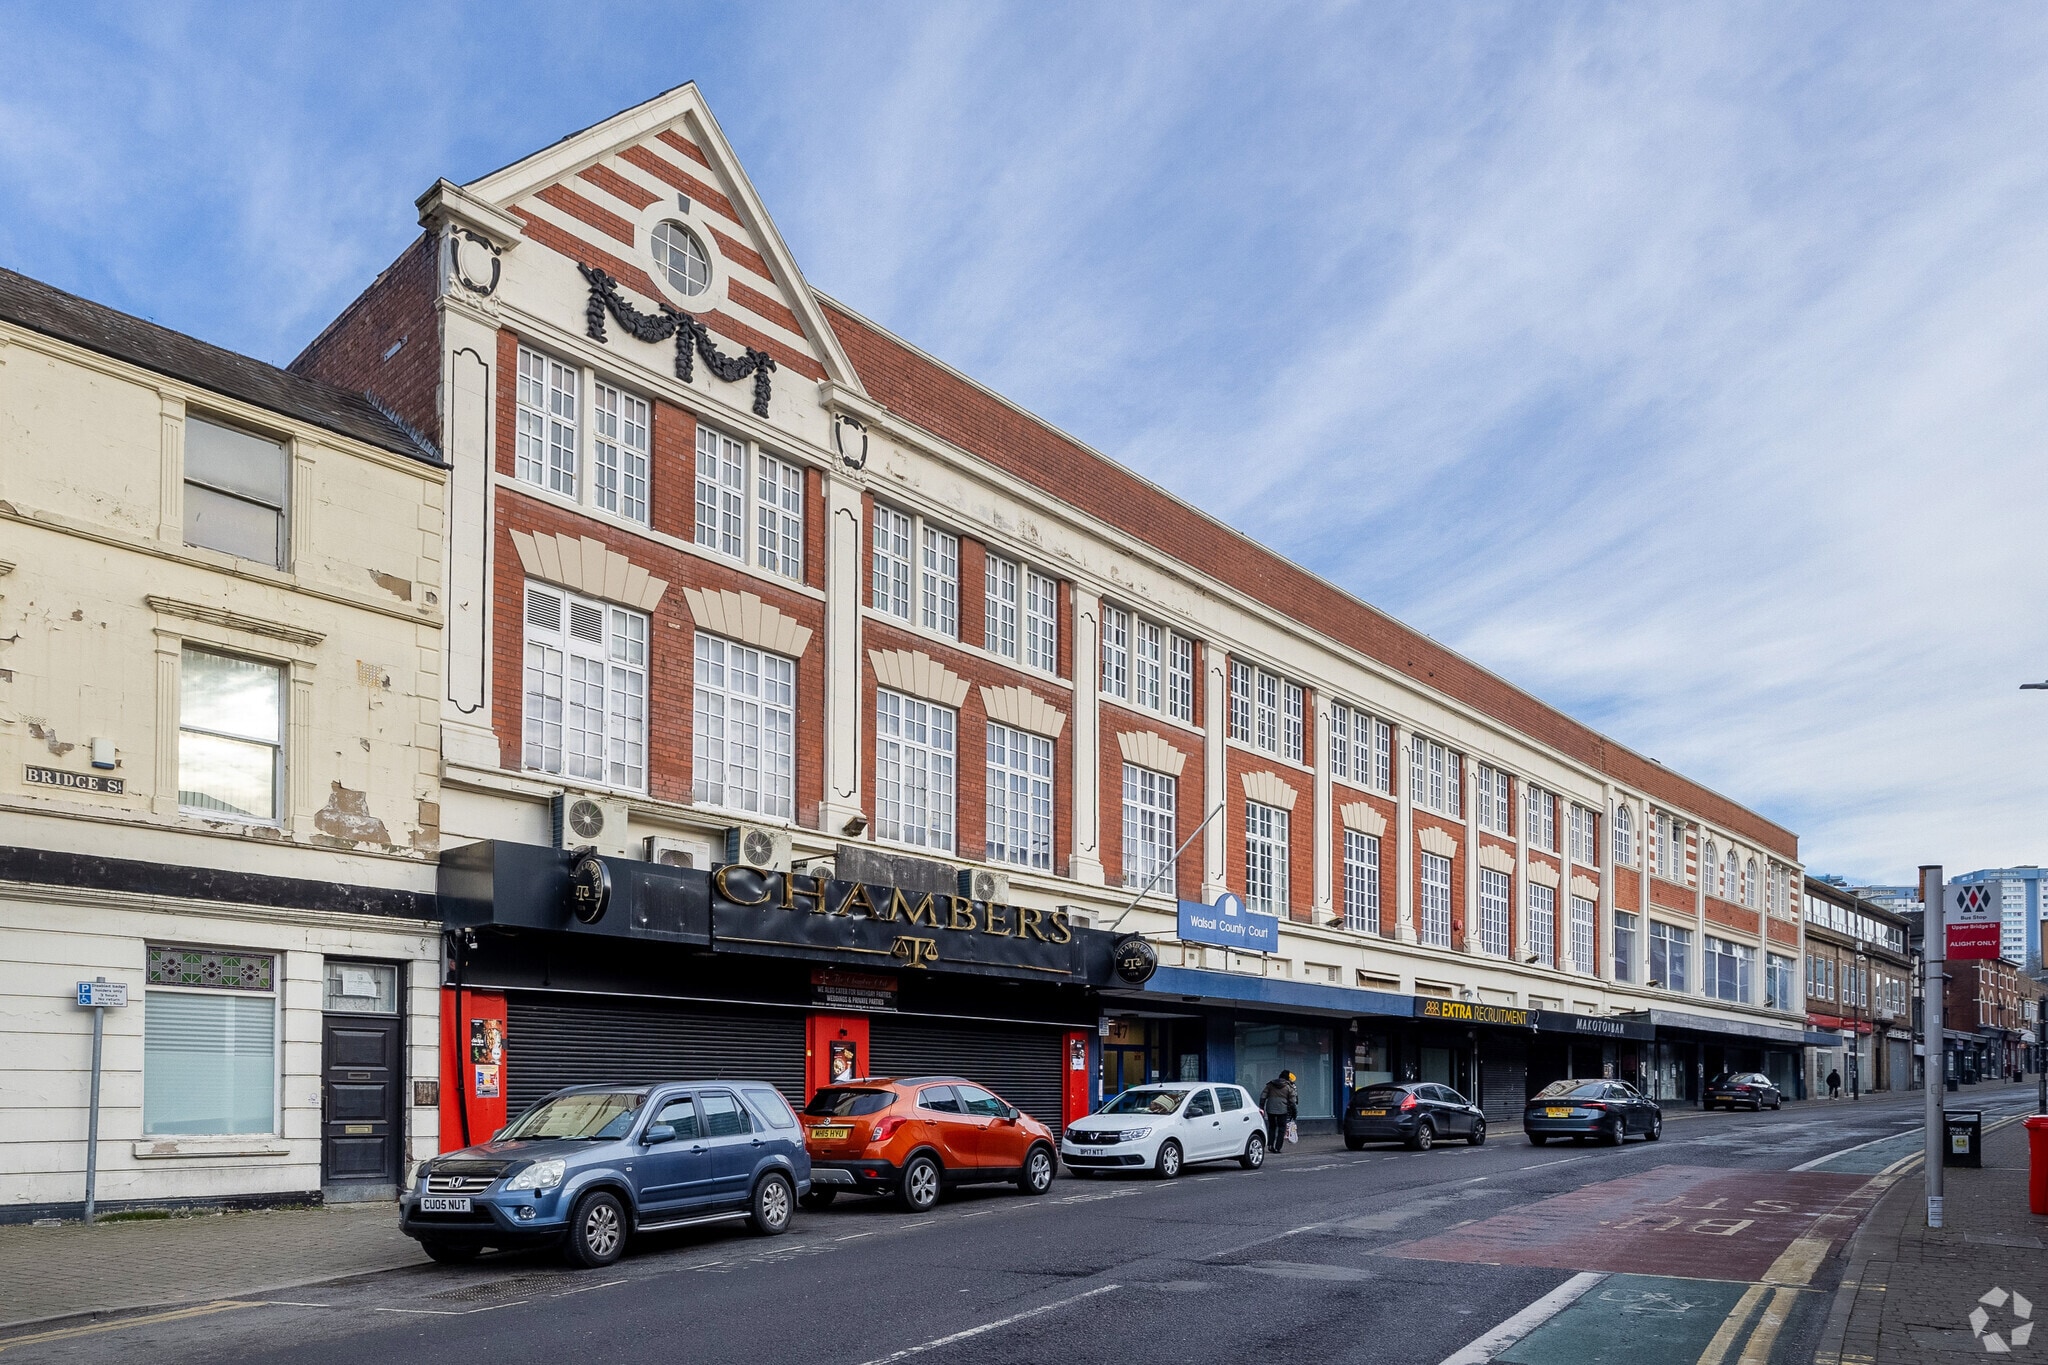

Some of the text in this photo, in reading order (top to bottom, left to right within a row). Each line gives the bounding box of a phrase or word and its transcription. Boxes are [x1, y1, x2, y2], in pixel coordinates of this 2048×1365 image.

[27, 768, 98, 790] BRIDGE
[715, 864, 1073, 945] CHAMBERS
[1190, 916, 1268, 938] Walsall County Court
[1442, 1002, 1527, 1024] EXTRA RECRUITMENT
[1114, 1023, 1128, 1038] 47
[424, 1200, 466, 1210] CU05 NUT
